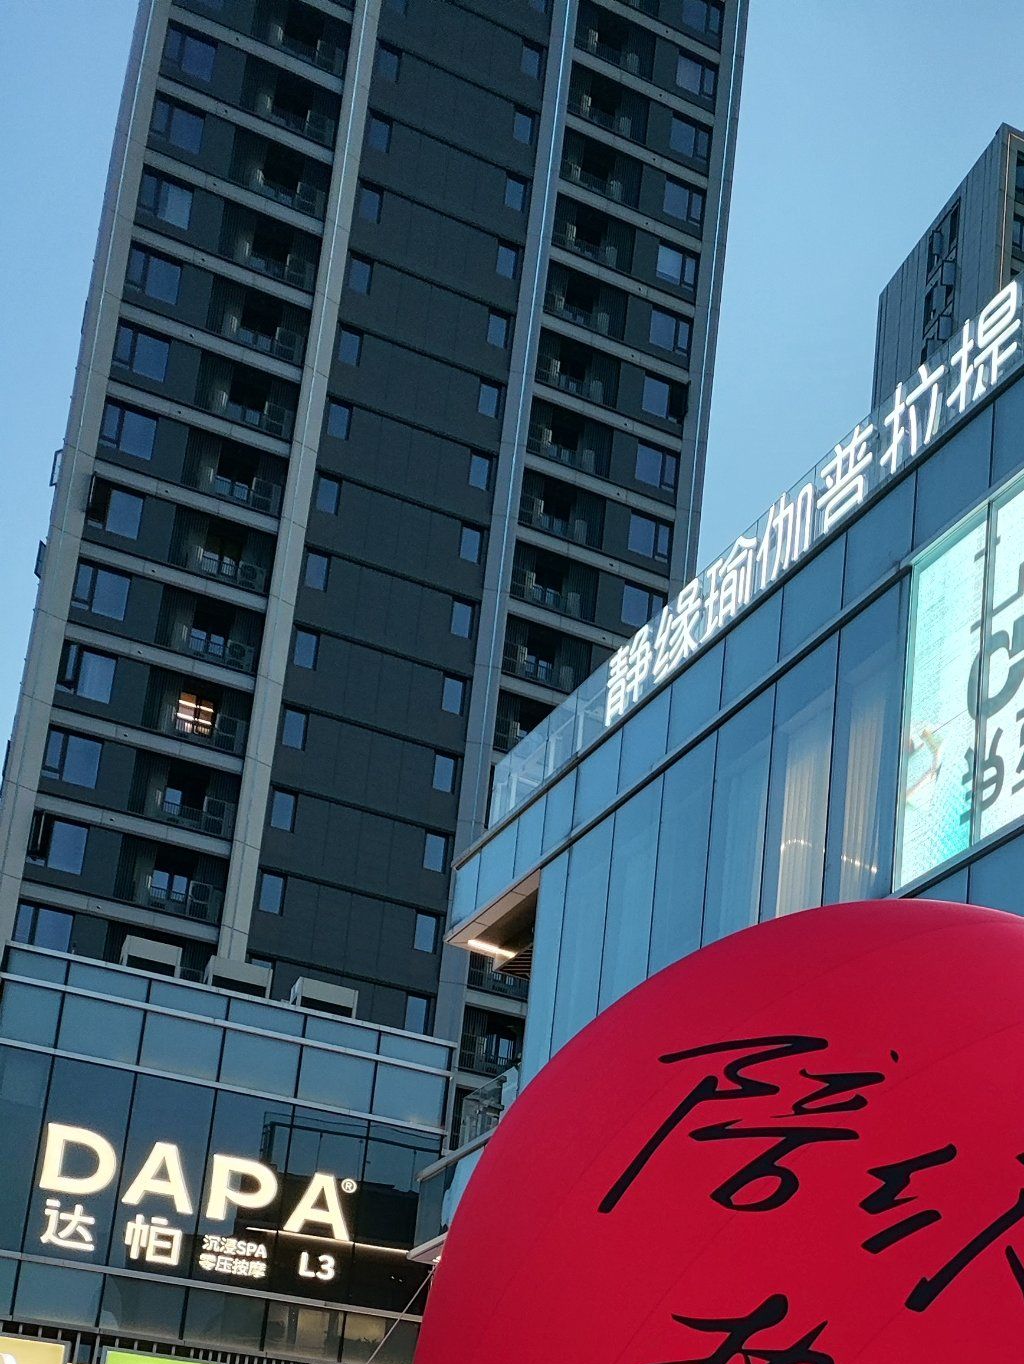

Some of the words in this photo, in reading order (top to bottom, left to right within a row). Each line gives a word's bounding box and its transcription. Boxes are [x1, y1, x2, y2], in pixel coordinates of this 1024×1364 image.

[604, 281, 1022, 726] 静缘瑜伽普拉提
[202, 1234, 267, 1258] 沉浸SPA
[299, 1251, 335, 1280] L3
